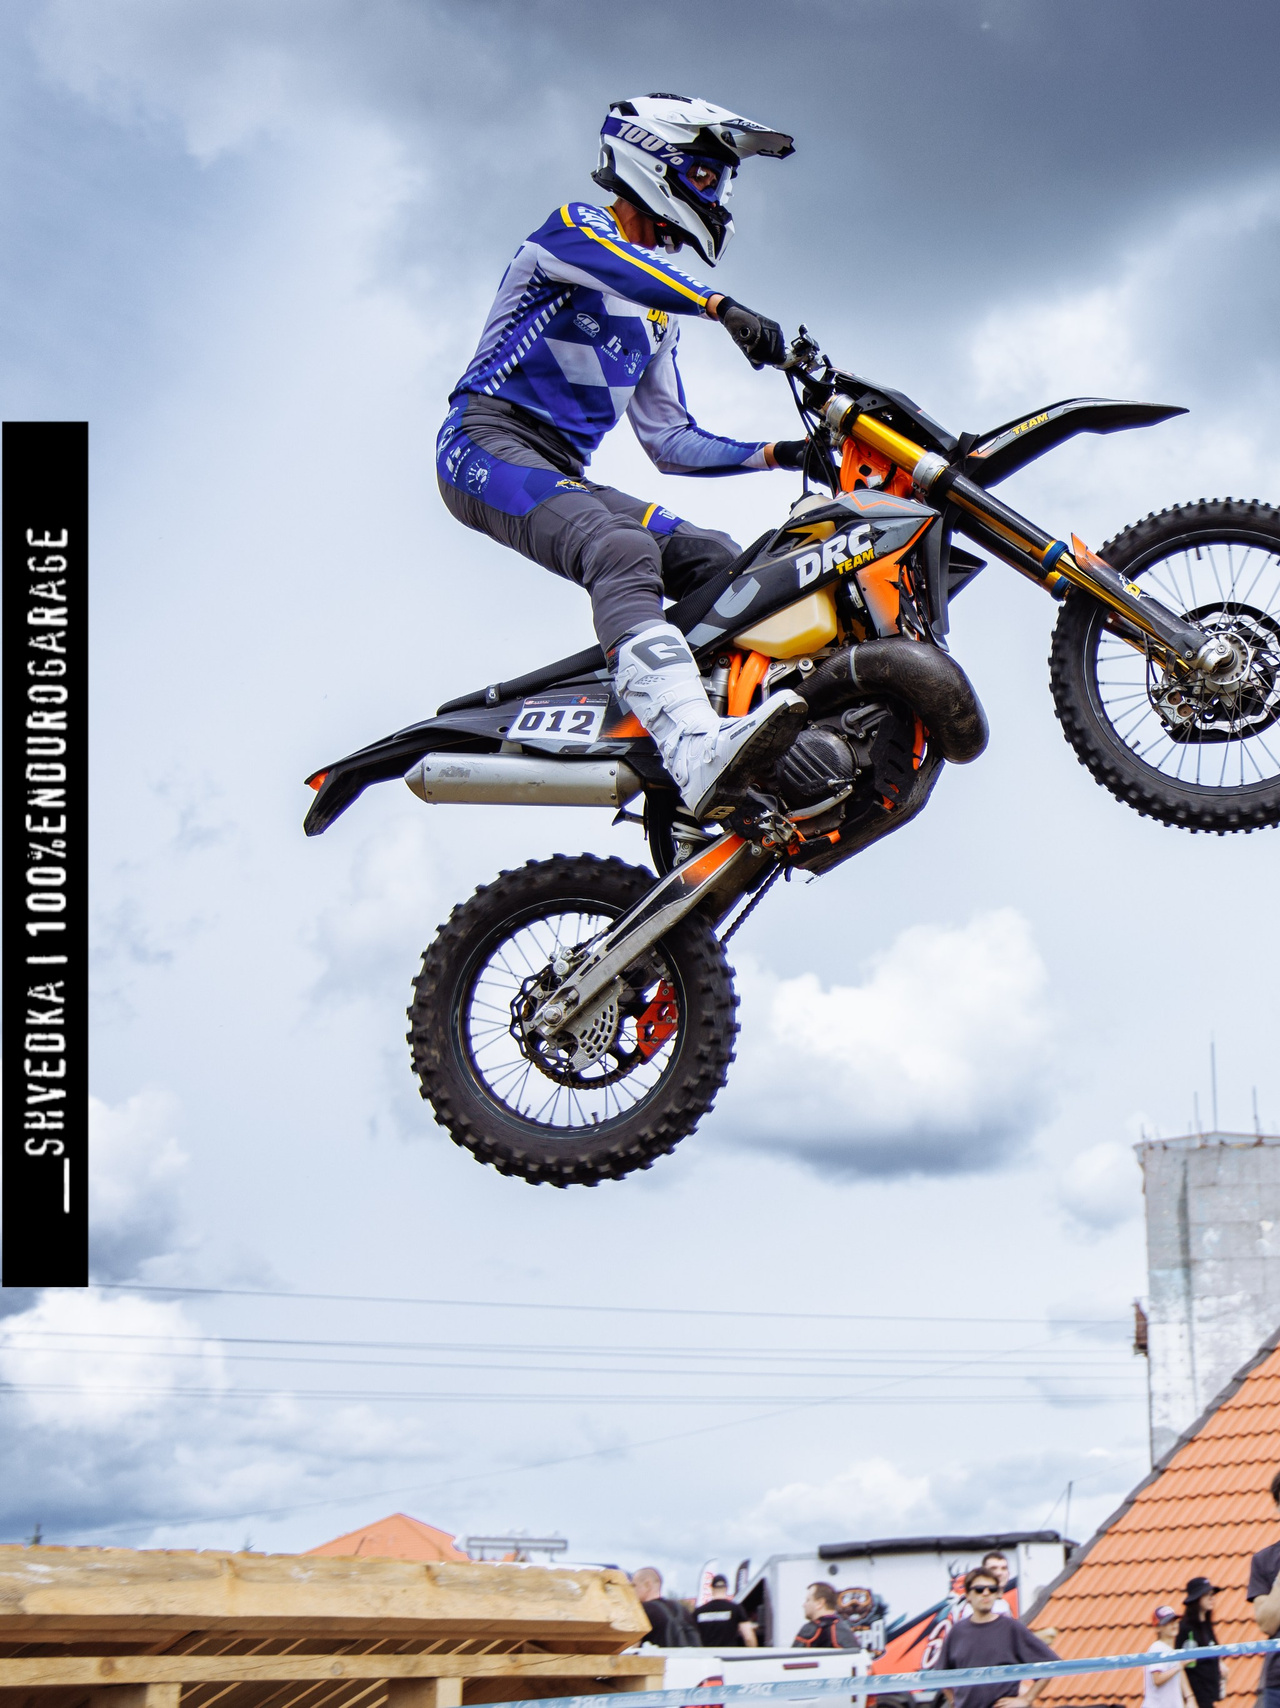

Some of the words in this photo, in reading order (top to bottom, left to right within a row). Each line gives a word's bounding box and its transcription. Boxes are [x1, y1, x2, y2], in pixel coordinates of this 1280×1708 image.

[615, 122, 685, 166] 100%
[1012, 412, 1049, 435] TEAM
[796, 523, 873, 589] DRC
[836, 548, 875, 575] TEAM
[518, 710, 595, 736] 012
